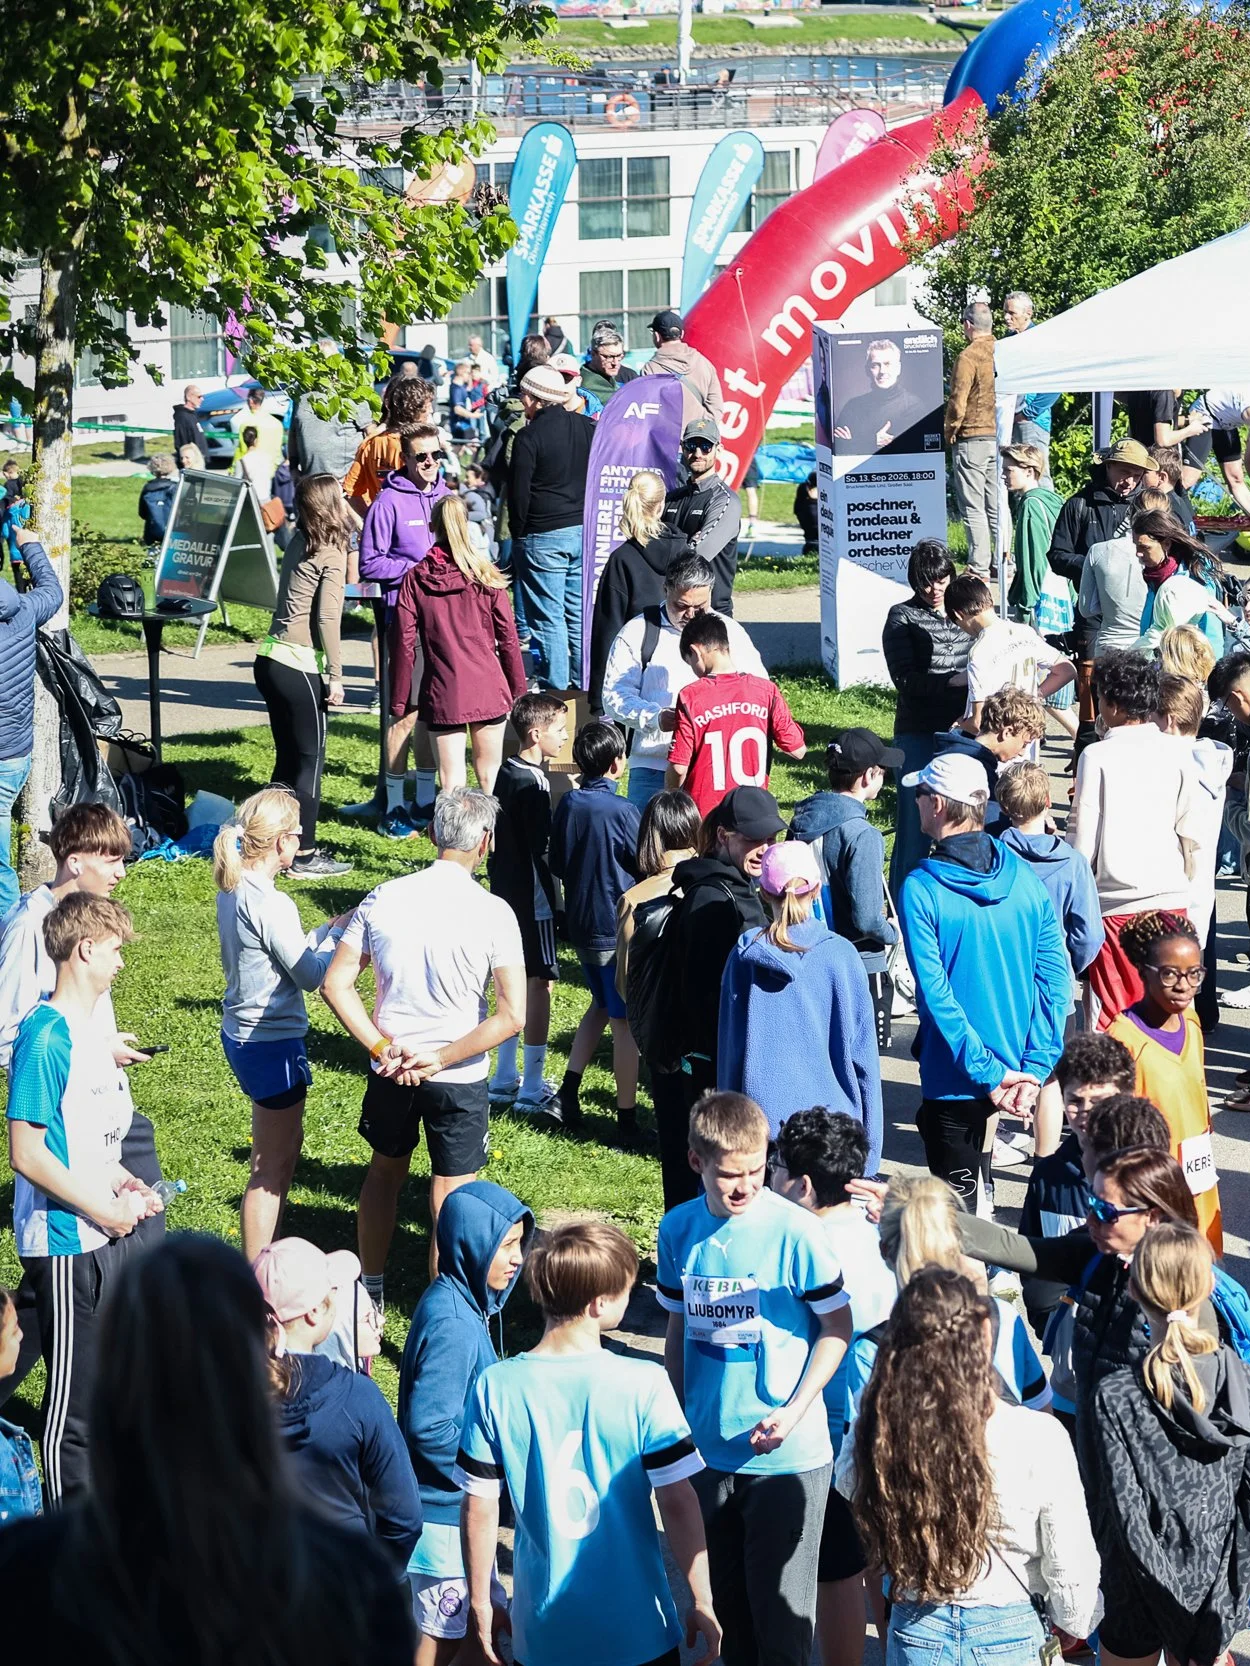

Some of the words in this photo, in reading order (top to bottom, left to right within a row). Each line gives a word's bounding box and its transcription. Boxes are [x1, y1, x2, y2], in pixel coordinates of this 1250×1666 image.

[513, 153, 558, 260] SPARKASSE
[692, 158, 744, 248] SPARKASSE
[761, 190, 939, 357] movin
[623, 402, 660, 419] AF
[600, 476, 630, 488] FITN
[845, 474, 858, 483] So,
[859, 474, 870, 482] 13.
[871, 474, 887, 483] Sep
[912, 472, 934, 480] 18:00
[847, 498, 917, 515] poschner,
[847, 513, 908, 527] rondeau
[910, 512, 921, 525] &
[847, 529, 913, 542] bruckner
[168, 538, 220, 555] MEDAILLE
[172, 552, 214, 567] GRAVUR
[694, 702, 769, 728] RASHFORD
[704, 726, 768, 791] 10
[693, 1279, 745, 1293] KEBA
[688, 1302, 755, 1319] LIUBOMYR
[547, 1429, 601, 1541] 6
